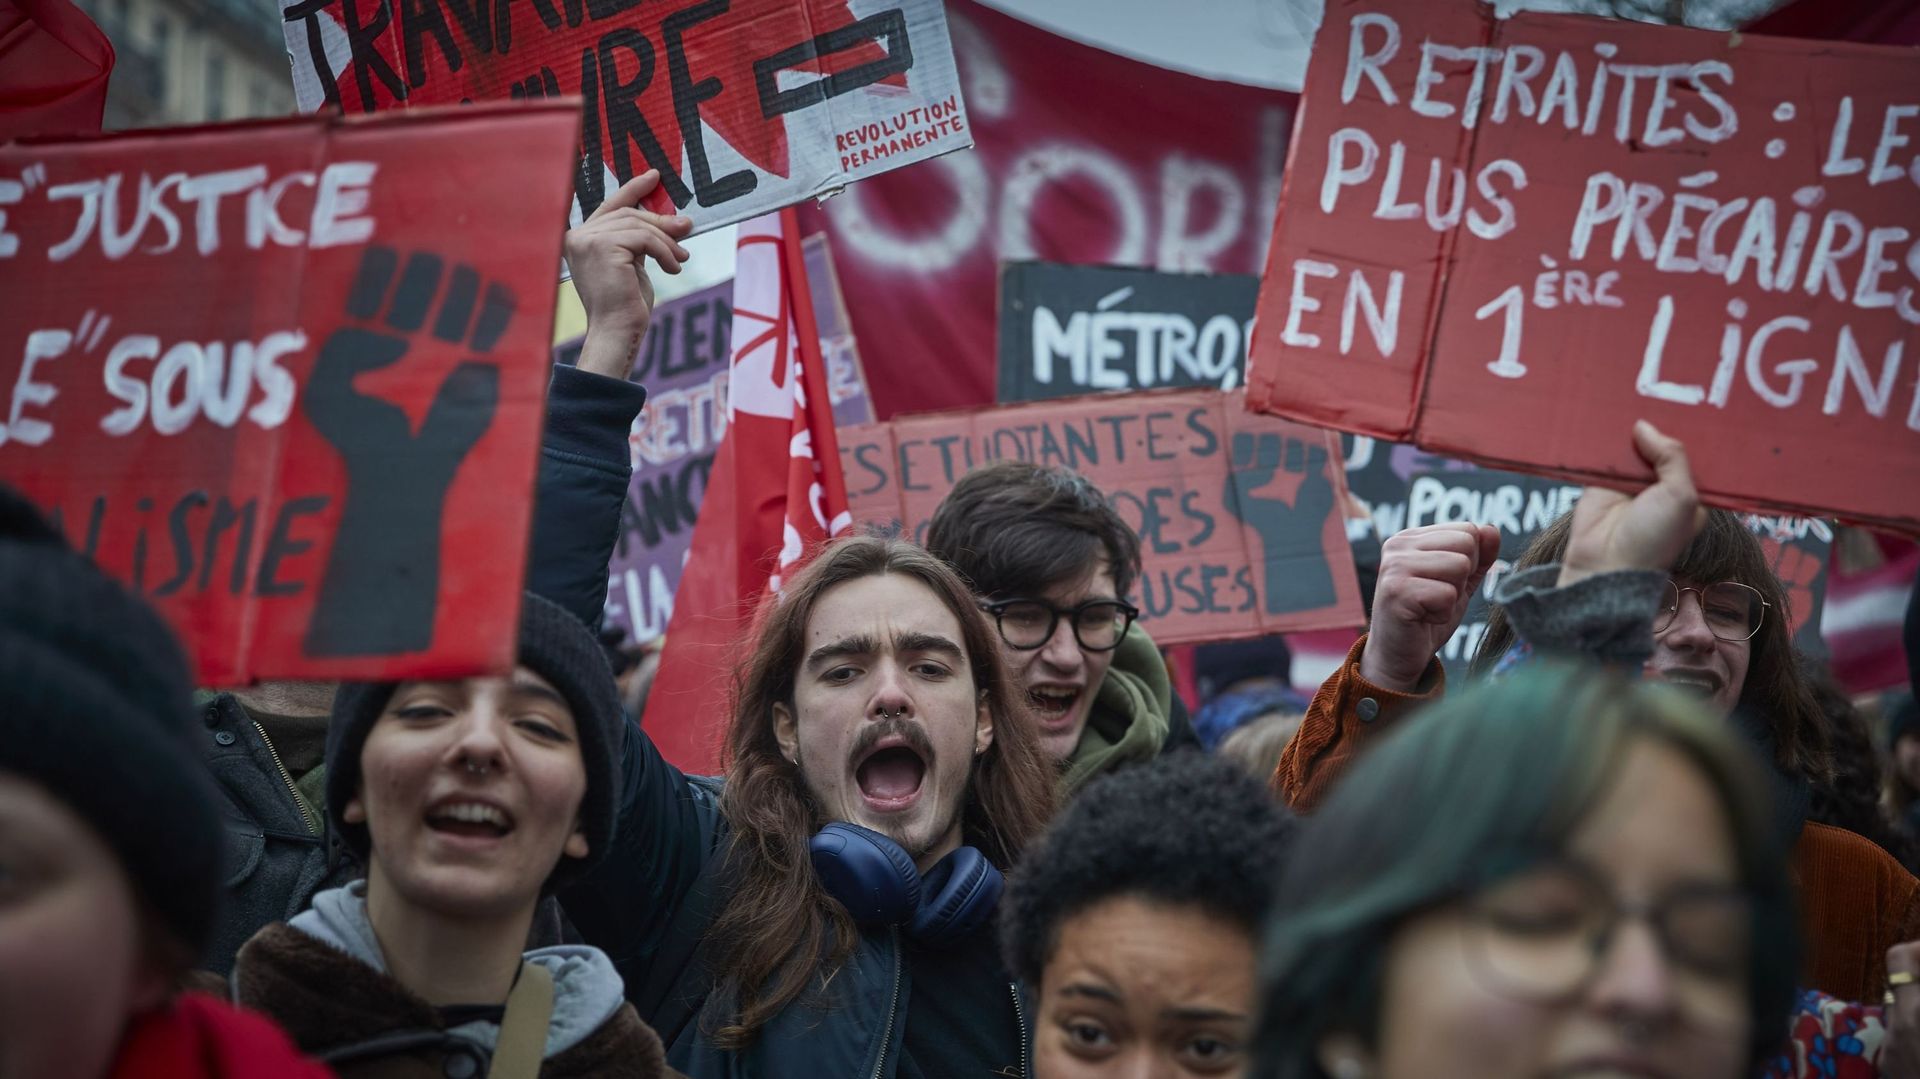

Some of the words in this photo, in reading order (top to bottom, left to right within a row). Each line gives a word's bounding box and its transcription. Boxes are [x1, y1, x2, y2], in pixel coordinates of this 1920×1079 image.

[836, 94, 957, 152] REVOLUTION
[840, 115, 964, 173] PERMANENTE
[1822, 96, 1920, 196] LE
[47, 162, 378, 262] JUSTICE
[1320, 127, 1529, 240] PLUS
[1281, 259, 1404, 357] EN
[100, 328, 308, 437] SOUS
